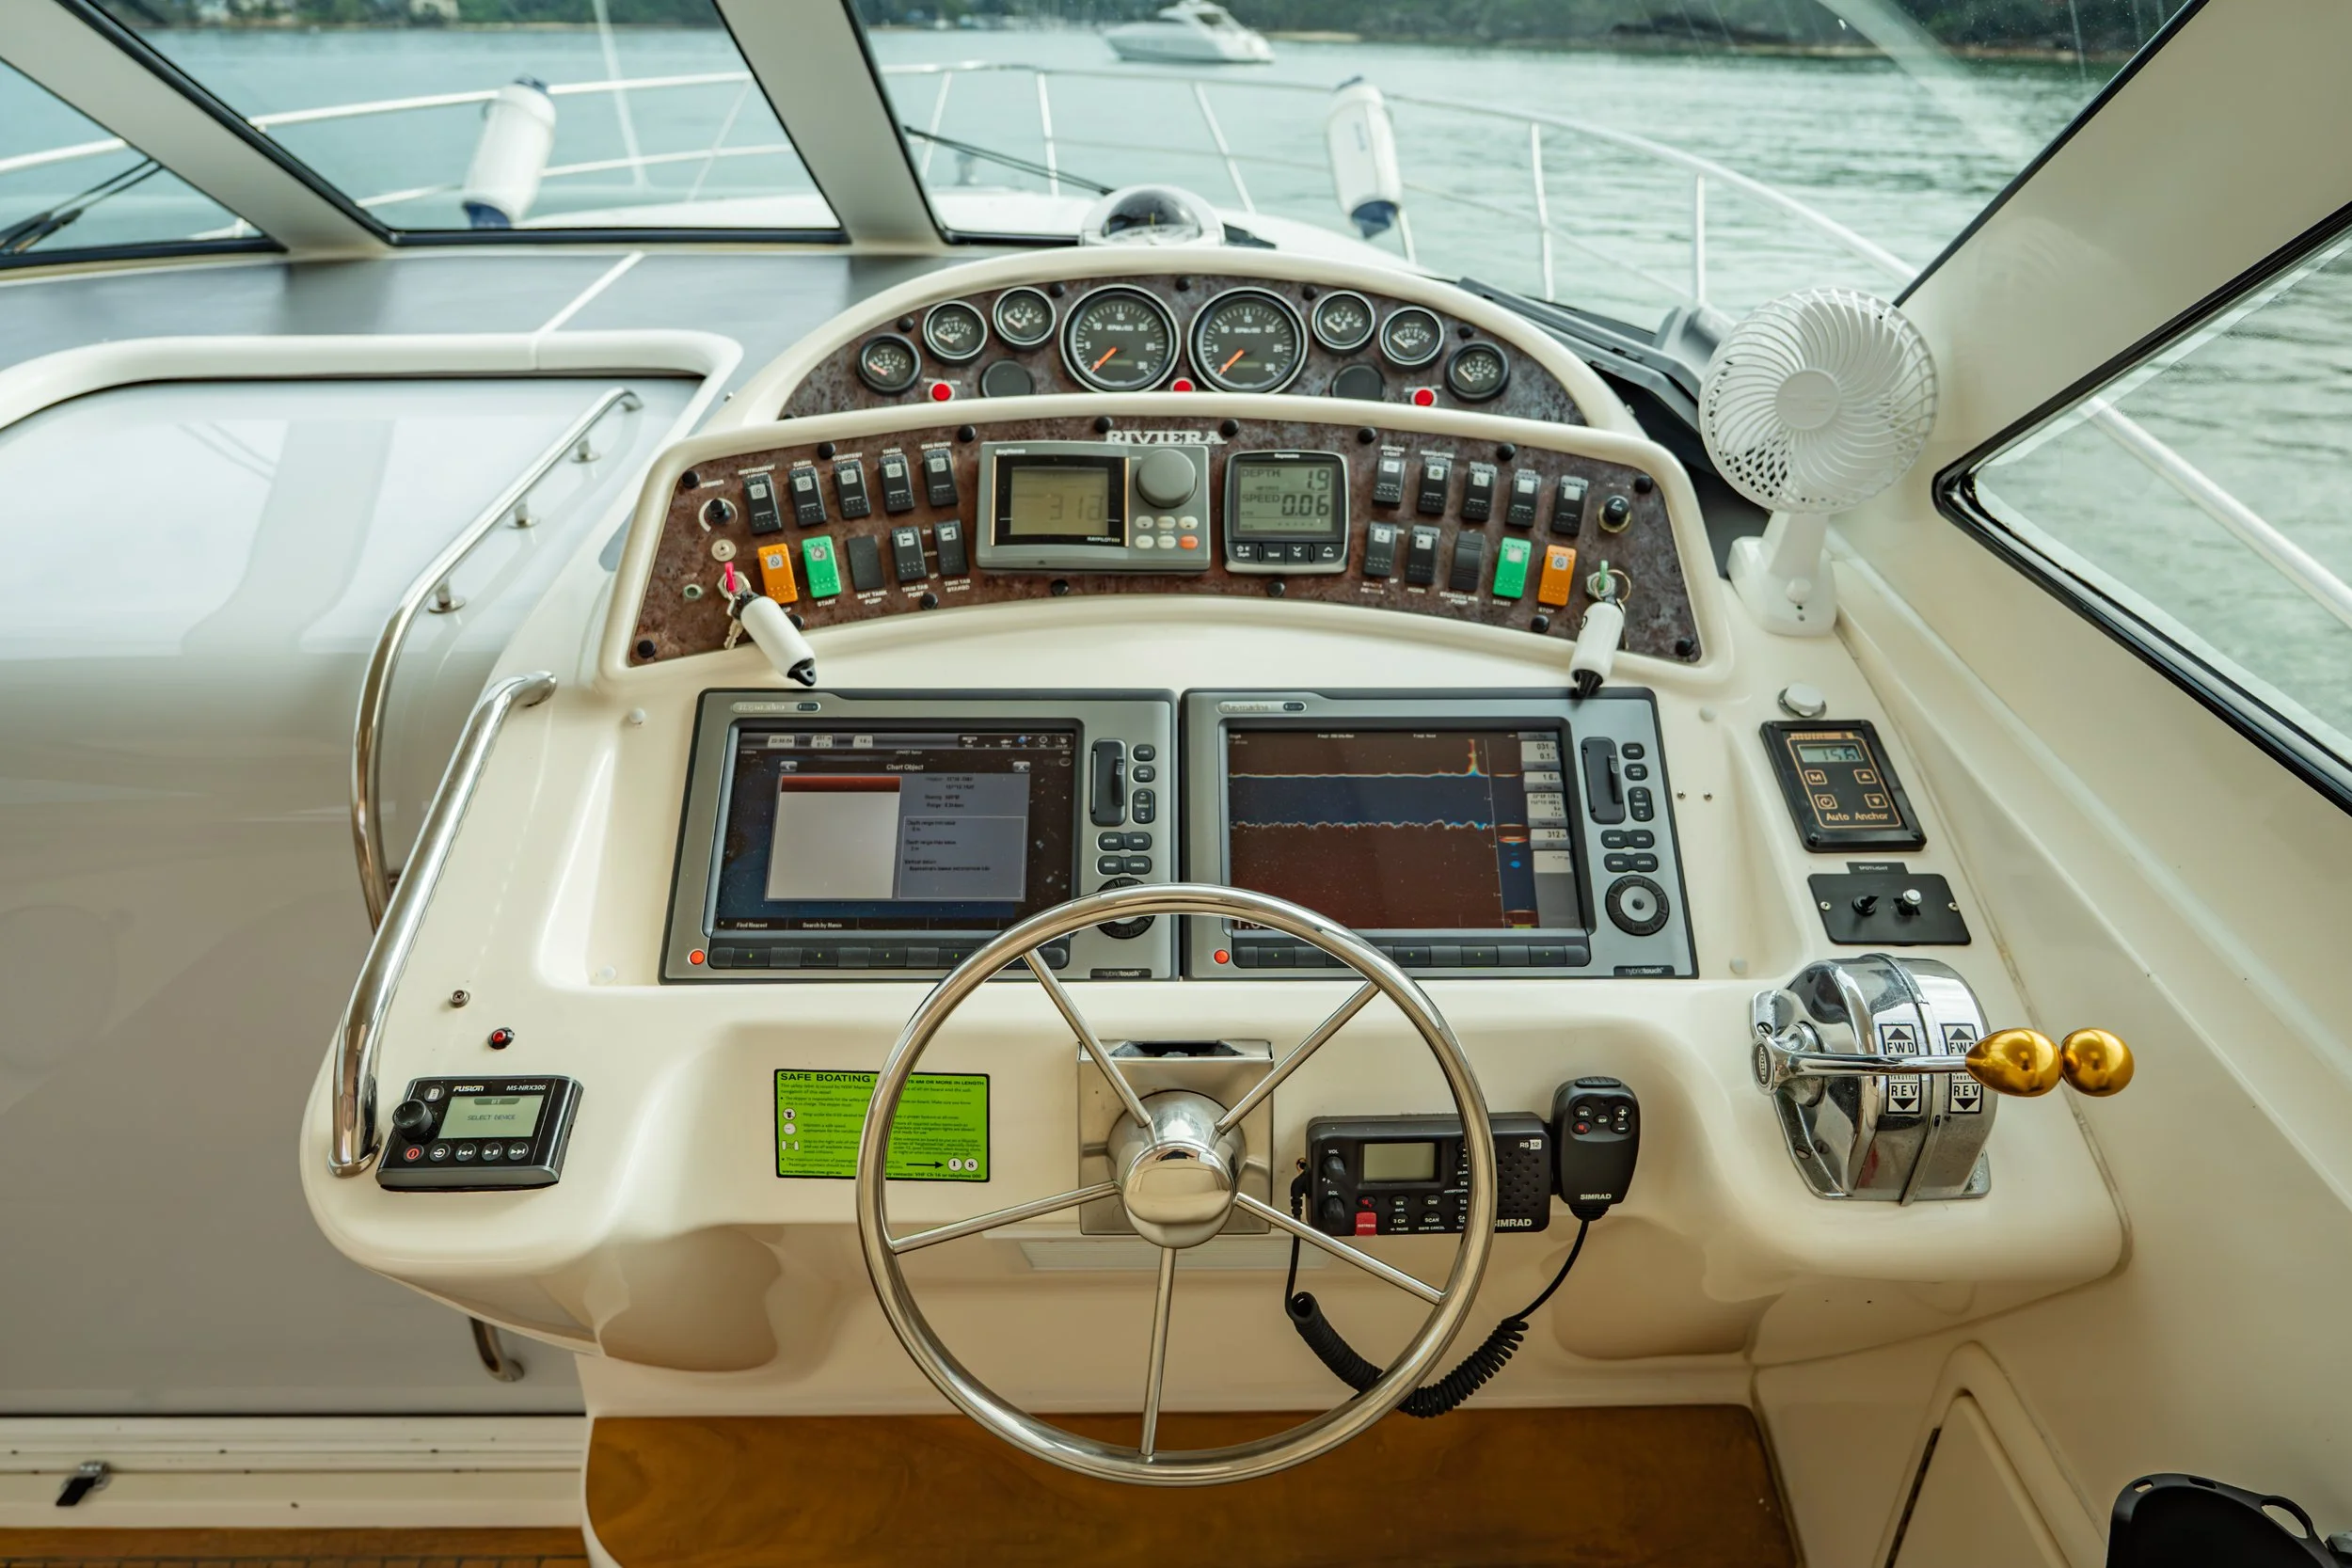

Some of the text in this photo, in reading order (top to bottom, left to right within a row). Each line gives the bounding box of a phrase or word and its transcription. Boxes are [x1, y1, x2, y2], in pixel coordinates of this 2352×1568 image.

[1213, 344, 1218, 353] 5
[1105, 430, 1227, 445] RIVIERA
[1242, 469, 1280, 478] DEPTH
[1242, 494, 1329, 515] SPEED 0.06
[904, 764, 924, 772] Object
[1855, 812, 1888, 820] Anchor
[1888, 1042, 1915, 1053] FWD
[817, 1074, 870, 1083] BOATING
[1891, 1085, 1918, 1096] REV
[1953, 1085, 1979, 1096] REV
